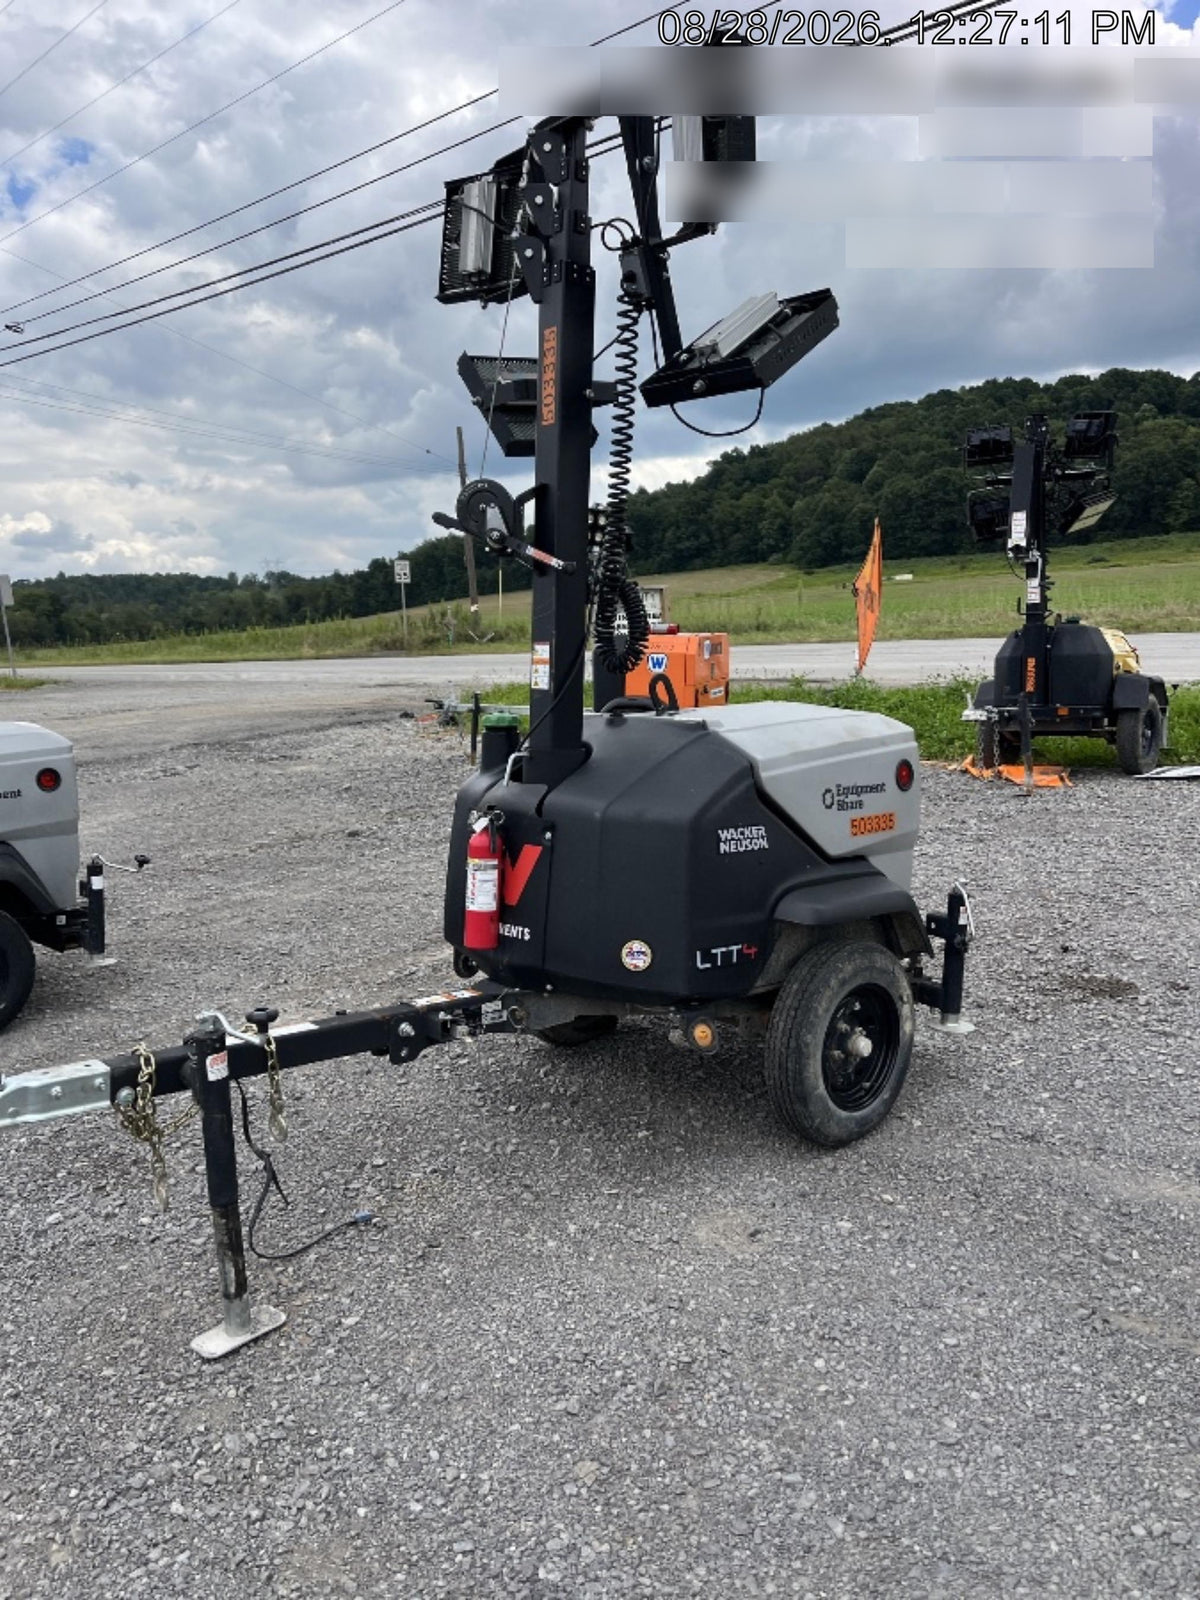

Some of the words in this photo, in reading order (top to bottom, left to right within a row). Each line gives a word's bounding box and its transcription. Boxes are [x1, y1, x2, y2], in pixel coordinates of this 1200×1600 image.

[650, 655, 666, 670] W
[836, 782, 886, 798] Equipment
[836, 799, 864, 811] Share
[851, 813, 895, 836] 503335
[718, 826, 767, 841] WACKER
[719, 837, 769, 854] NEUSON
[696, 944, 758, 970] LTT4
